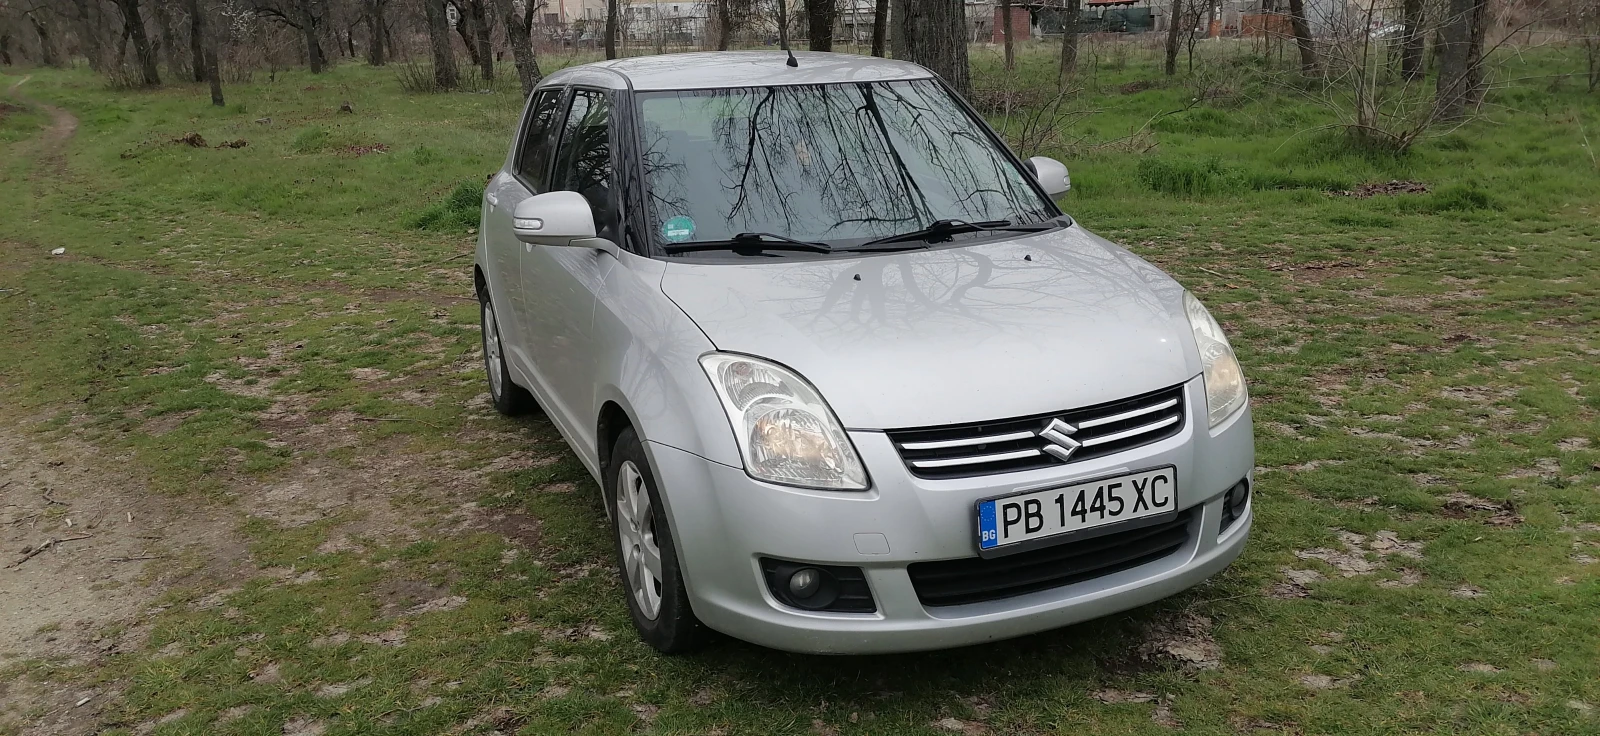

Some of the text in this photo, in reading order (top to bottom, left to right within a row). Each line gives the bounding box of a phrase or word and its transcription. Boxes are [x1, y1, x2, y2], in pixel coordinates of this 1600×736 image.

[1002, 474, 1169, 538] PB 1445 XC
[982, 529, 996, 542] BG
